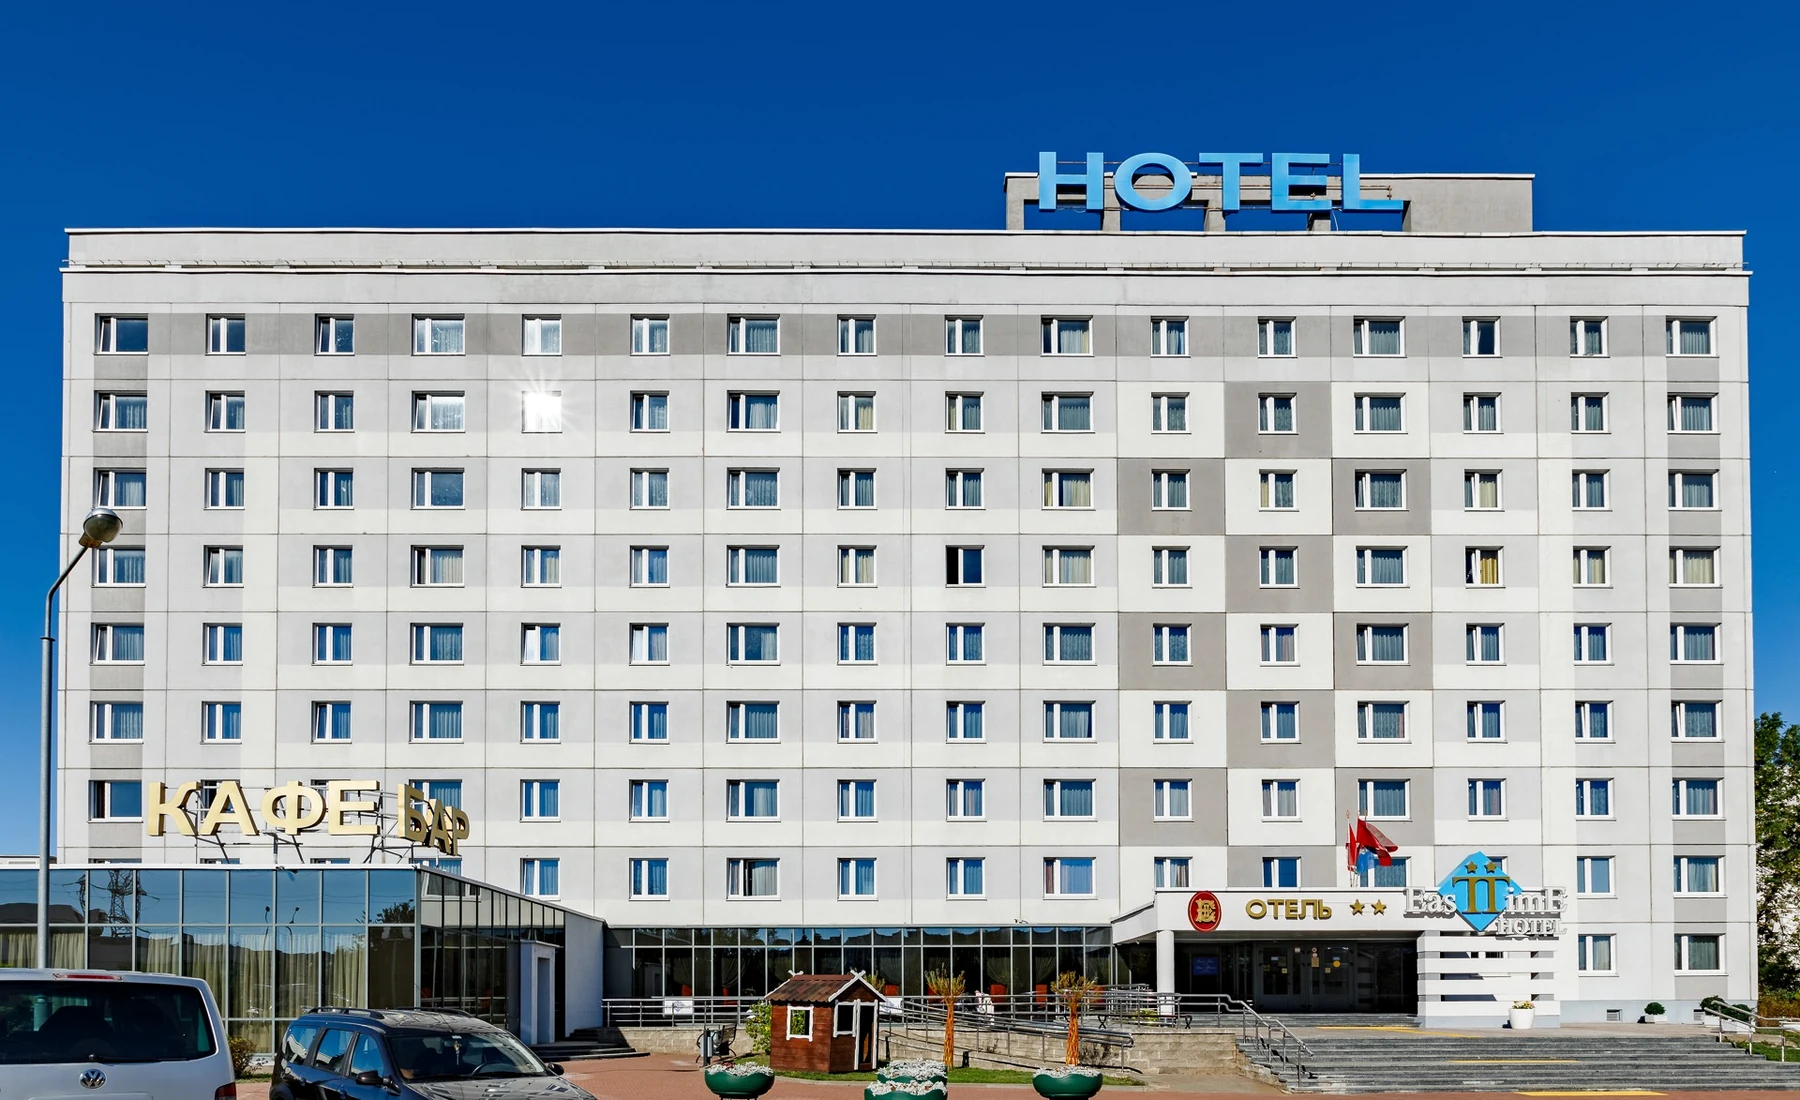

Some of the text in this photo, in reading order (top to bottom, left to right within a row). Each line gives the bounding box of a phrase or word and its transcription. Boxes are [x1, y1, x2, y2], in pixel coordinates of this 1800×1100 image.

[1038, 151, 1404, 212] HOTEL
[146, 780, 470, 856] КАФЕ БАР
[1245, 899, 1332, 920] ОТЕЛЬ
[1496, 917, 1567, 935] HOTEL
